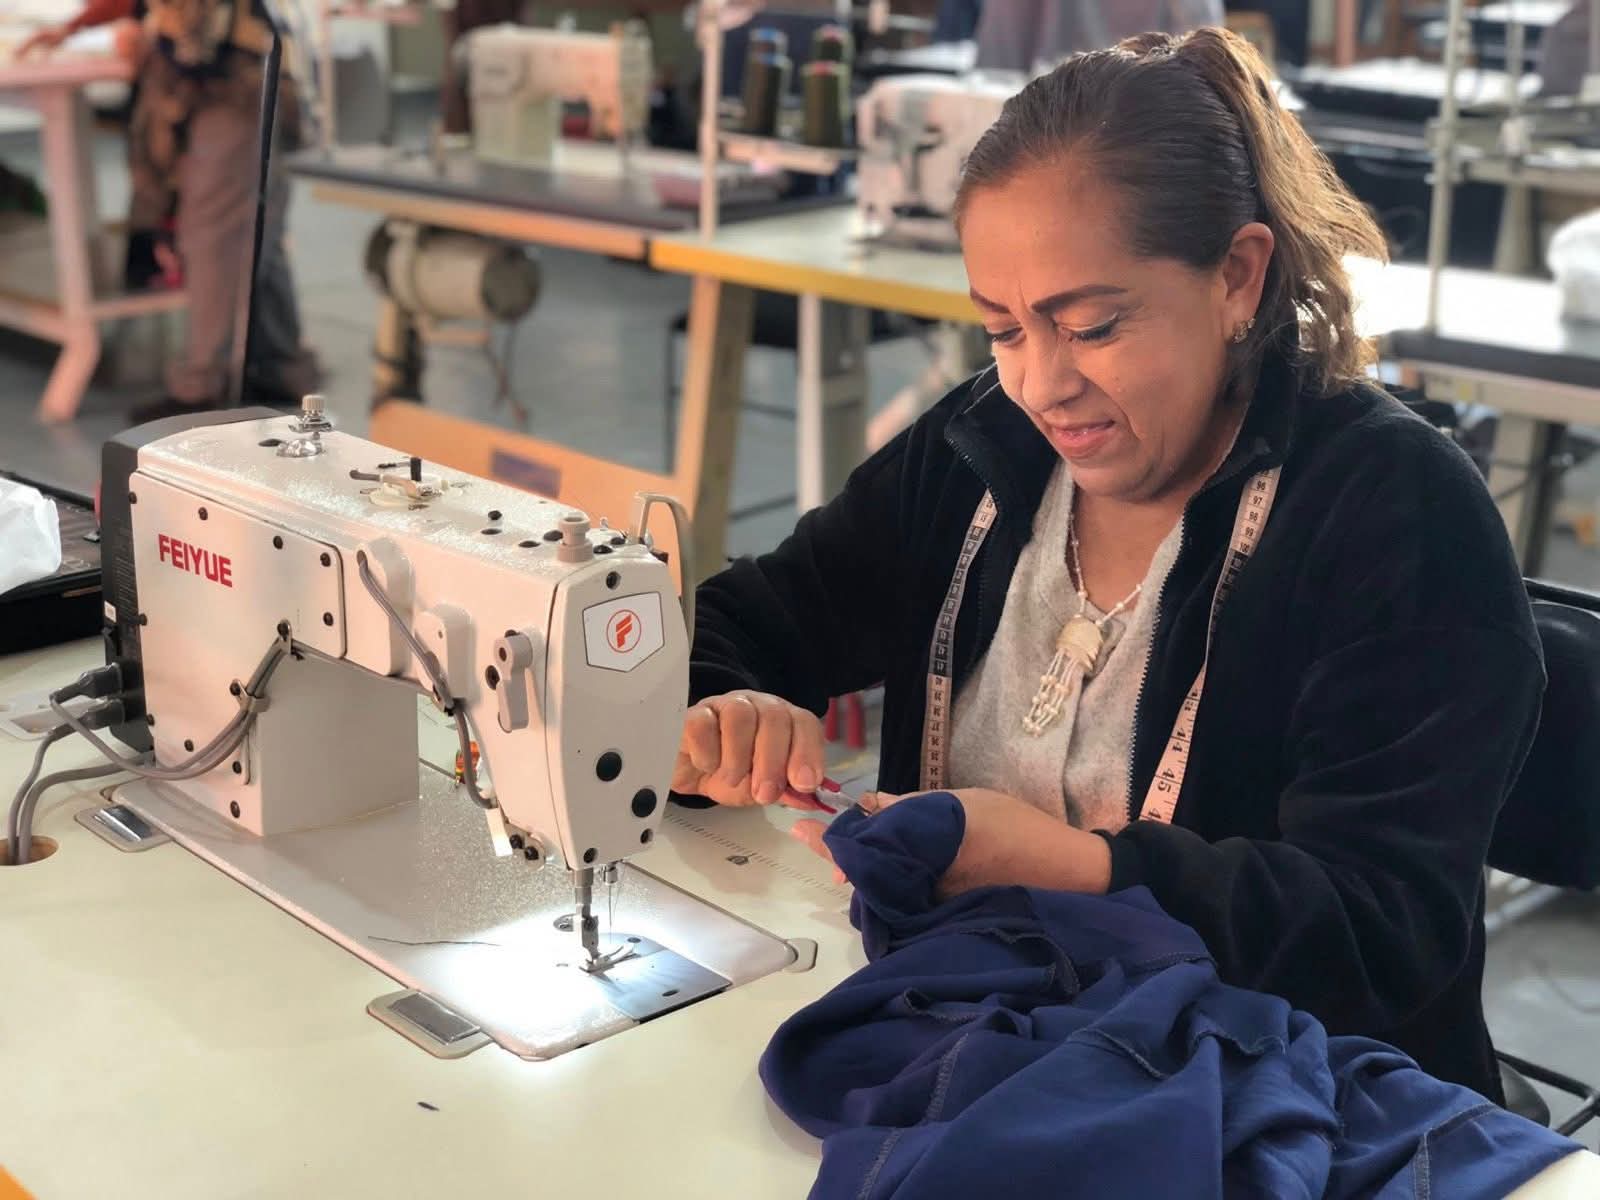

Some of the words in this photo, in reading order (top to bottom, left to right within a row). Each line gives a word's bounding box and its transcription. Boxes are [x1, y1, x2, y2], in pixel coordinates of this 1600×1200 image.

[1253, 495, 1263, 505] 97
[1245, 526, 1255, 537] 99
[158, 533, 233, 588] FEIYUE
[1172, 727, 1187, 753] 44
[1157, 767, 1176, 793] 45
